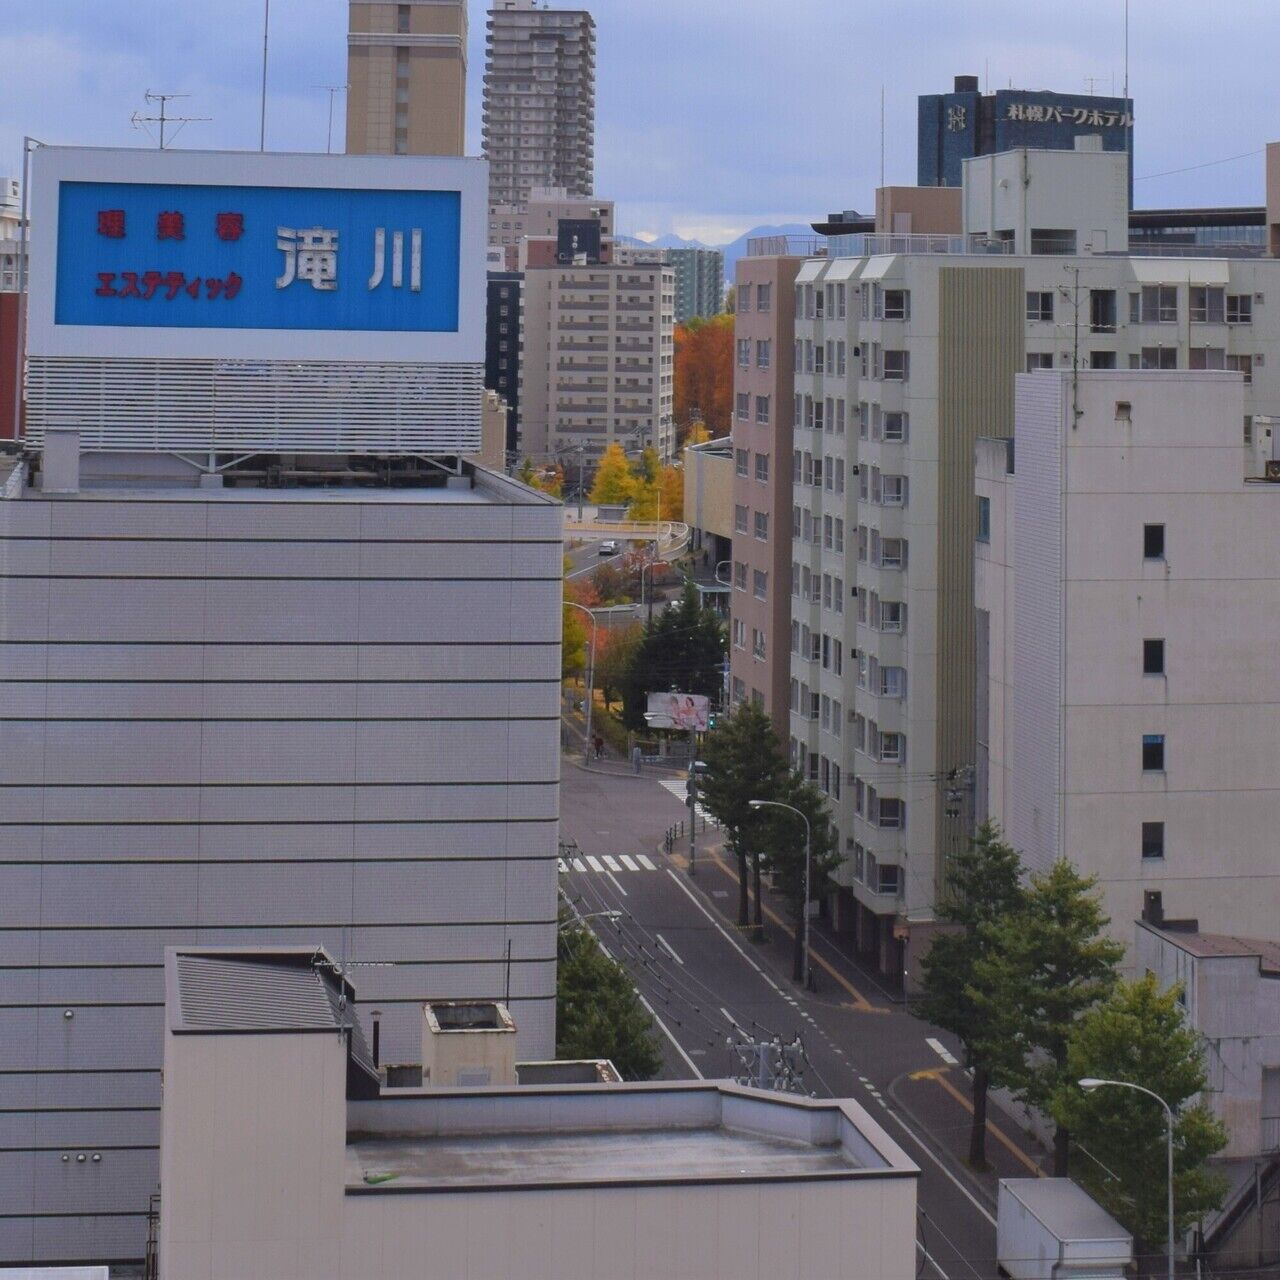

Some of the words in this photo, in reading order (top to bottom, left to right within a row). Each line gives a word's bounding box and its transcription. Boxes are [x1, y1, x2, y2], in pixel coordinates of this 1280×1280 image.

[1007, 104, 1135, 127] 札幌パークホテル
[276, 225, 423, 293] 滝川
[95, 271, 243, 300] エステティック
